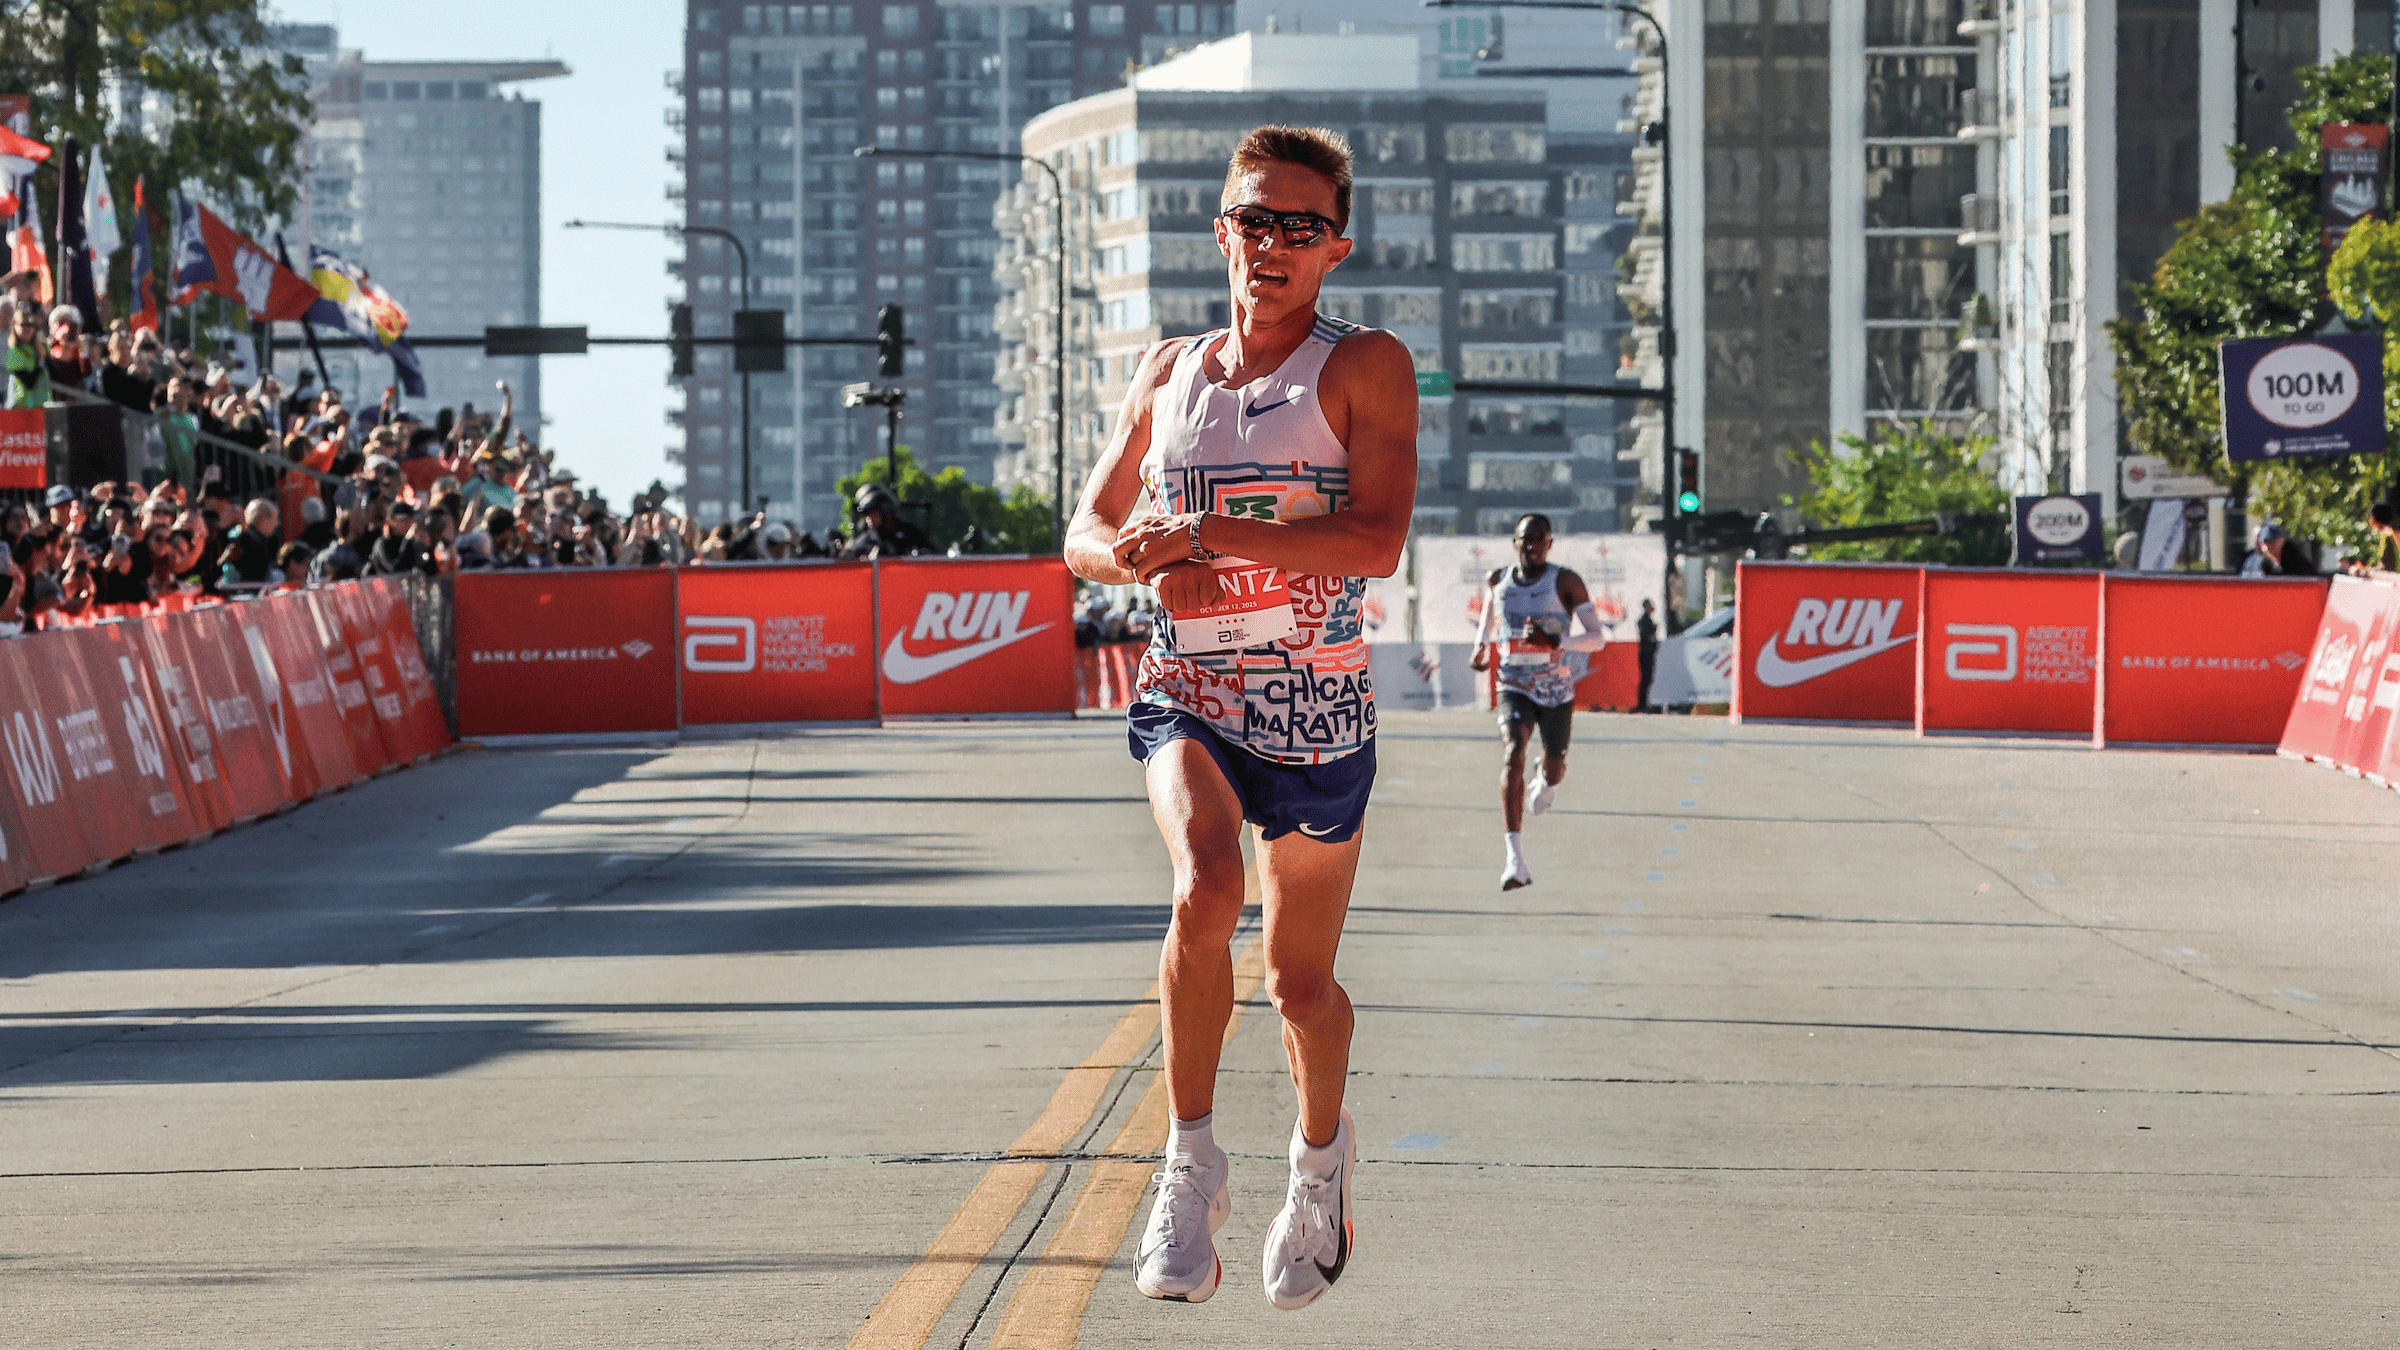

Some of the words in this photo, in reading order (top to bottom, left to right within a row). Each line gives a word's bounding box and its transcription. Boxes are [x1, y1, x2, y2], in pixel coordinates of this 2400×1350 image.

[2264, 371, 2344, 399] 100M
[2305, 401, 2325, 415] GO
[1217, 566, 1283, 598] NTZ
[1241, 600, 1258, 609] 2025
[763, 615, 825, 630] ABBOTT
[912, 590, 1031, 641] RUN
[1786, 598, 1903, 647] RUN
[763, 632, 823, 644] WORLD
[471, 649, 516, 663] BANK
[519, 648, 541, 662] OF
[543, 646, 618, 661] AMERICA
[763, 644, 855, 658] MARATHON
[2121, 655, 2167, 669] BANK
[2170, 656, 2192, 669] OF
[2195, 656, 2270, 671] AMERICA
[1264, 661, 1372, 706] CHICAG
[1243, 699, 1377, 753] MARATHO
